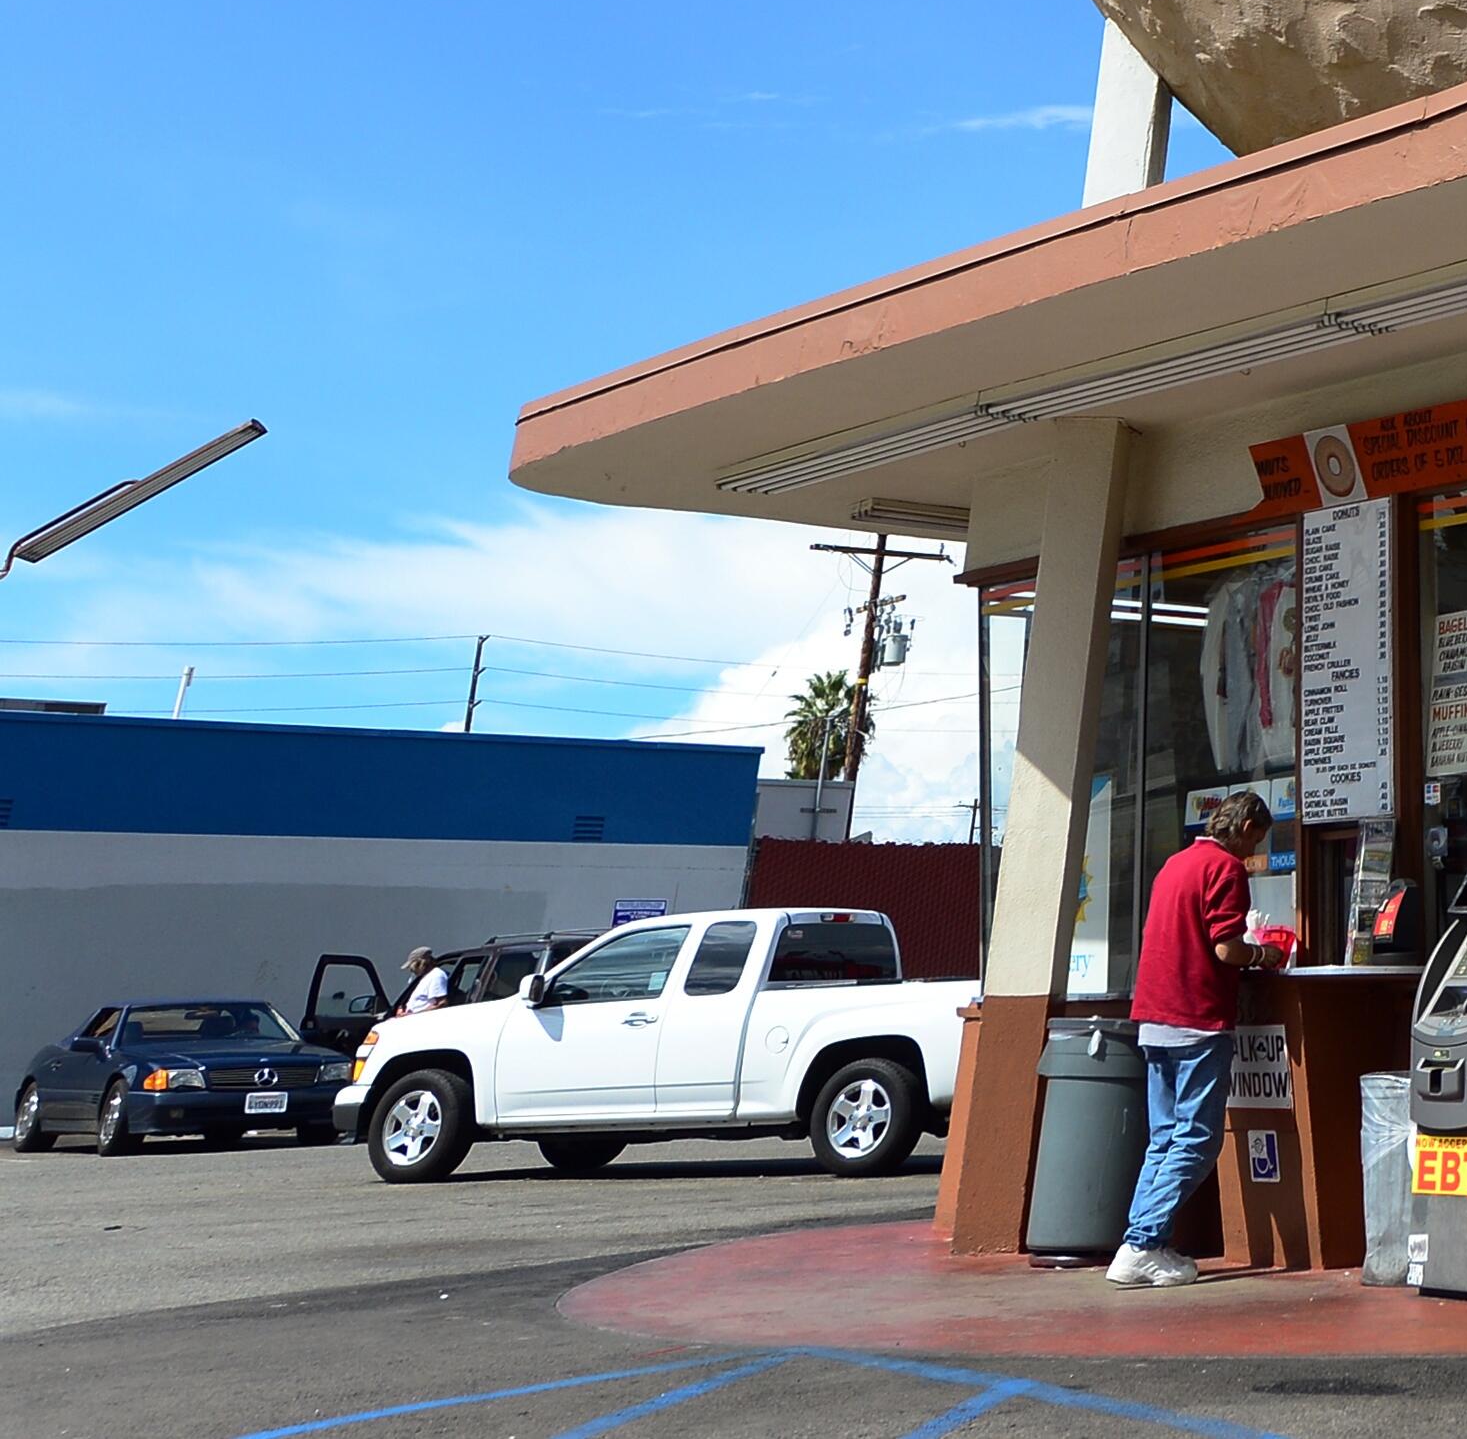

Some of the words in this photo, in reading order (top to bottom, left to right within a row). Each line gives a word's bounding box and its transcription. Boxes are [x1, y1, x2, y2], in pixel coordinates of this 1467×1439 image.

[1407, 421, 1460, 448] DISCOUNT
[1254, 456, 1290, 476] NUTS
[1372, 458, 1410, 482] ORDERS
[1414, 456, 1428, 472] OF
[1263, 478, 1301, 501] NJOYED
[1332, 506, 1360, 521] DONUTS
[1331, 668, 1360, 682] FANCIES
[1330, 771, 1362, 784] COOKIES
[1266, 1035, 1284, 1062] UP
[1416, 1138, 1436, 1148] NOW
